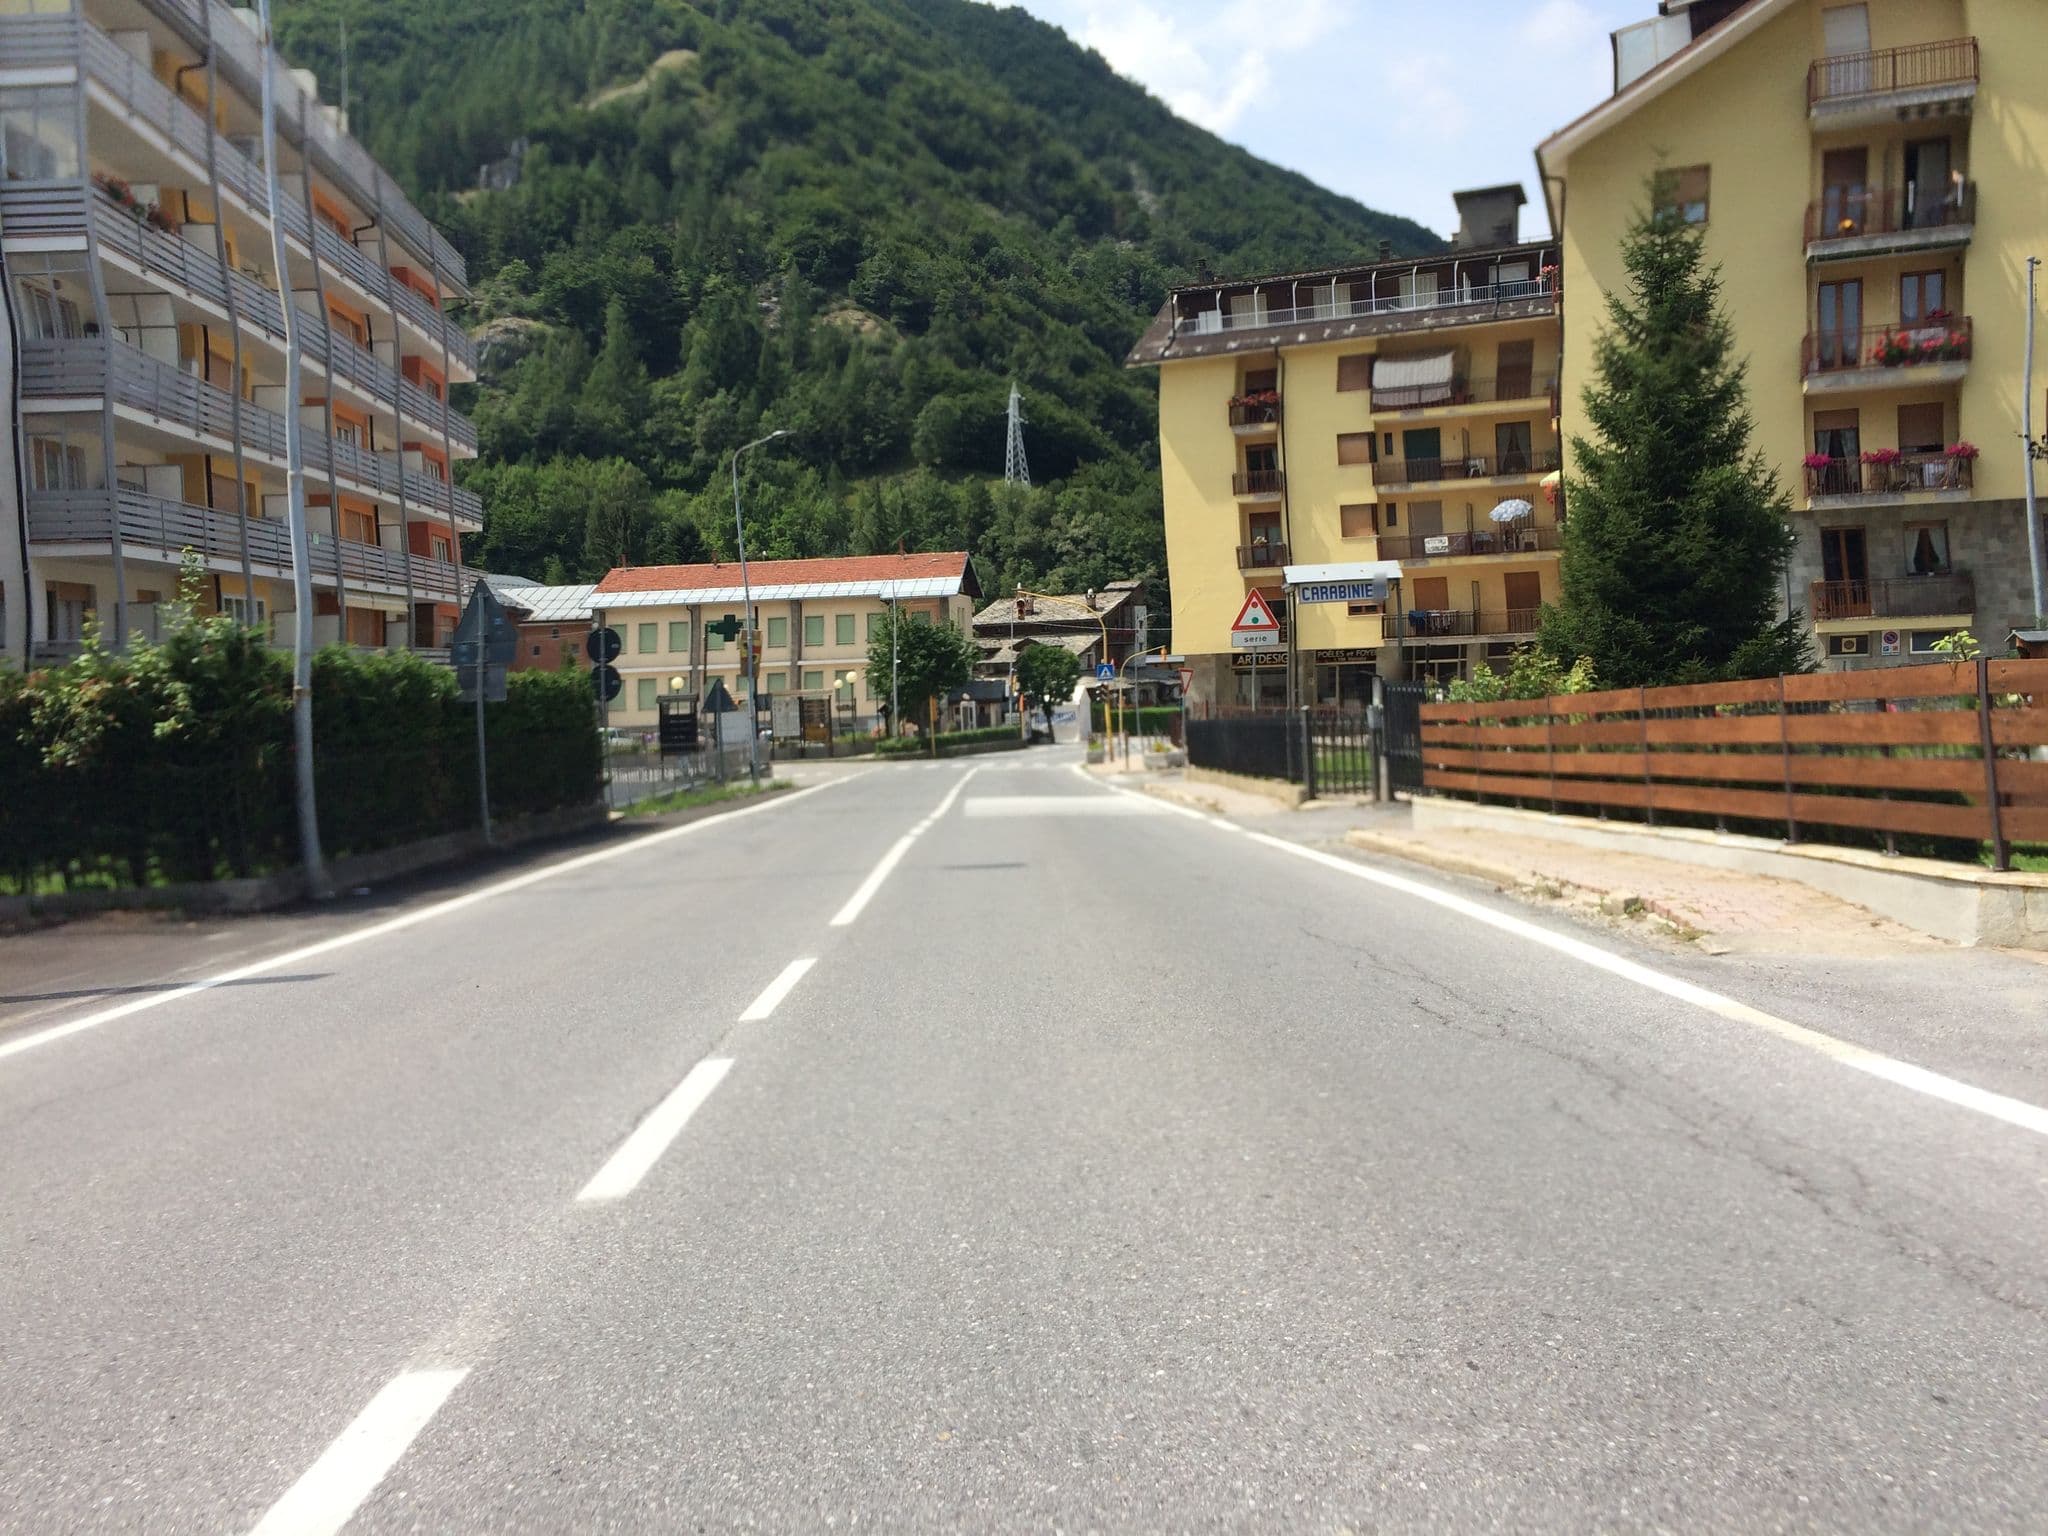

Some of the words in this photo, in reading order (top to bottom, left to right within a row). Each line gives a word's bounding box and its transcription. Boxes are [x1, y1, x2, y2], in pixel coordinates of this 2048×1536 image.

[1301, 583, 1384, 601] CARABINIE
[1244, 635, 1267, 643] serie
[1356, 649, 1377, 657] FOYE
